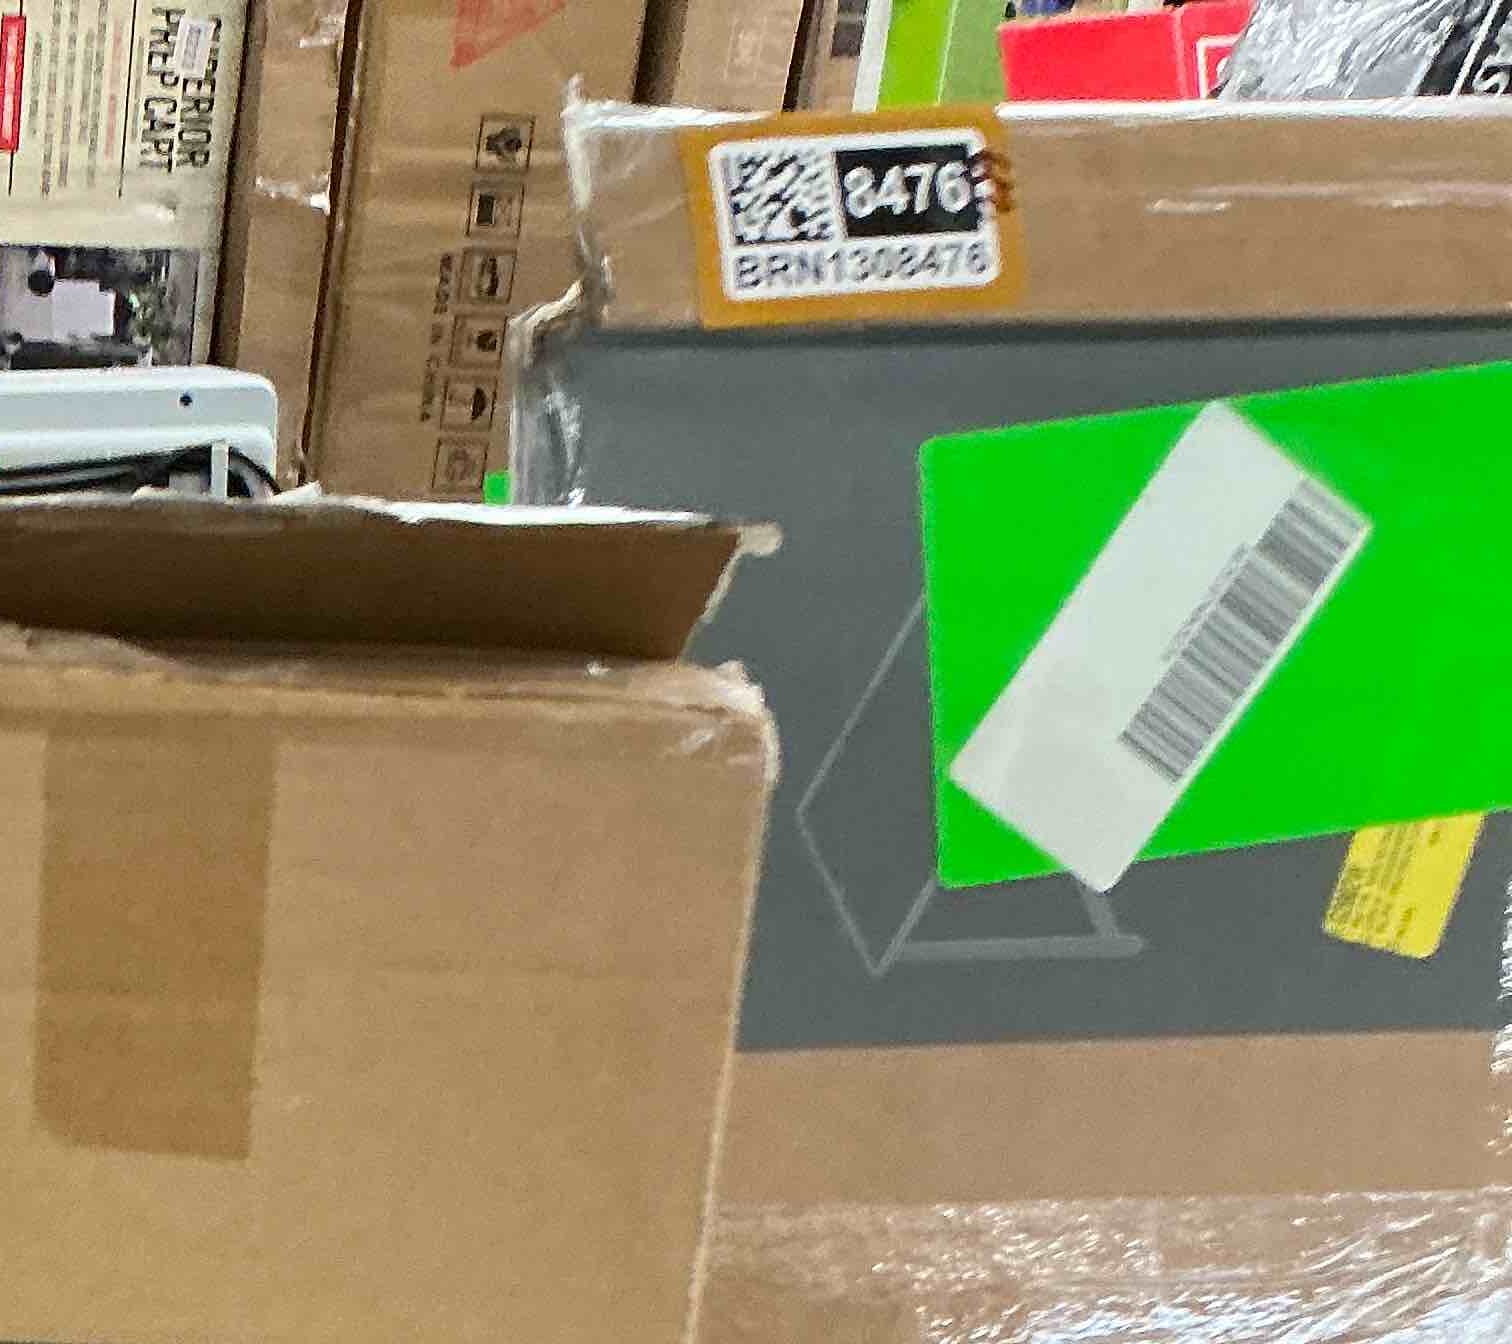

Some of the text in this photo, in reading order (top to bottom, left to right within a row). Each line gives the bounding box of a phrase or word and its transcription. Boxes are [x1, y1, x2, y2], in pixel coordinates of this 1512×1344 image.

[140, 97, 178, 173] CART
[843, 158, 972, 219] 8476
[735, 238, 989, 290] BRN1308476
